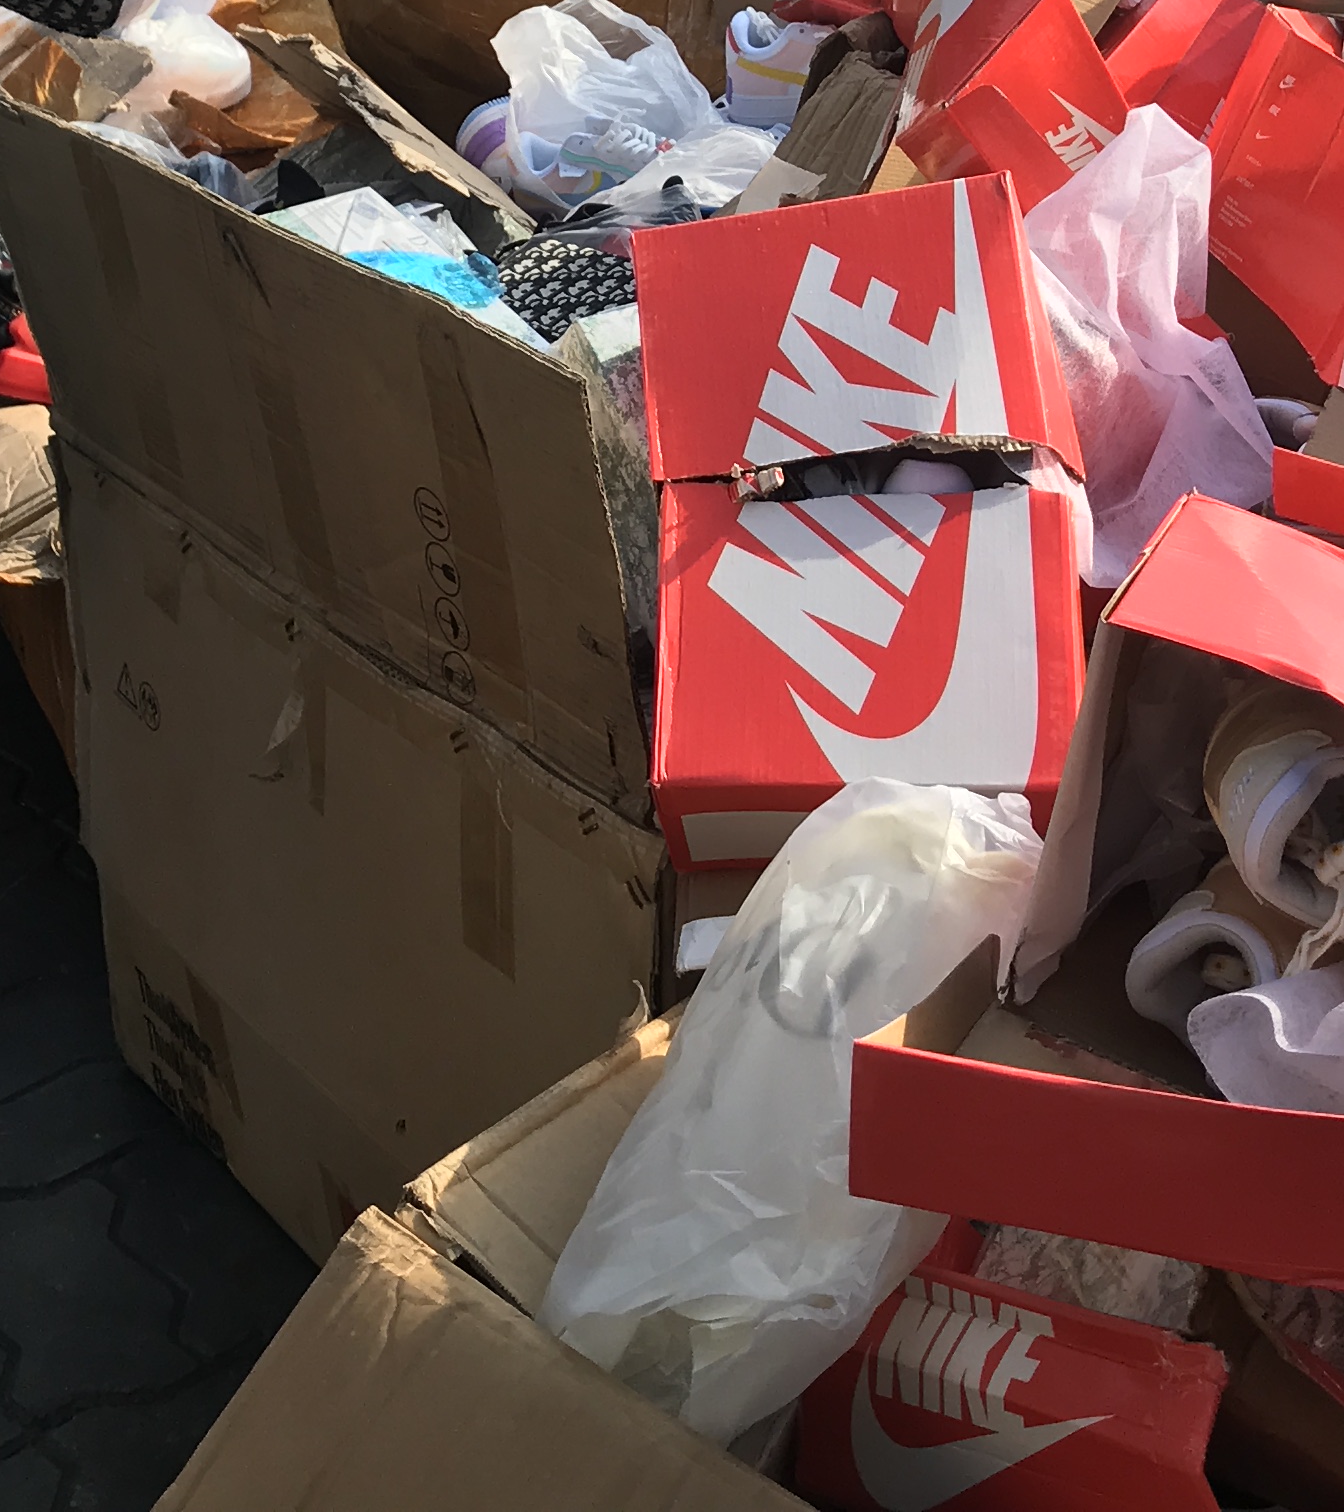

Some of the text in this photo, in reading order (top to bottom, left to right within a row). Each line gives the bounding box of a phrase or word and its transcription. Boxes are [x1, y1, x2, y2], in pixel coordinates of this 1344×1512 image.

[1044, 116, 1099, 172] IKE
[706, 243, 957, 716] NIKE
[875, 1275, 1055, 1433] NIKE
